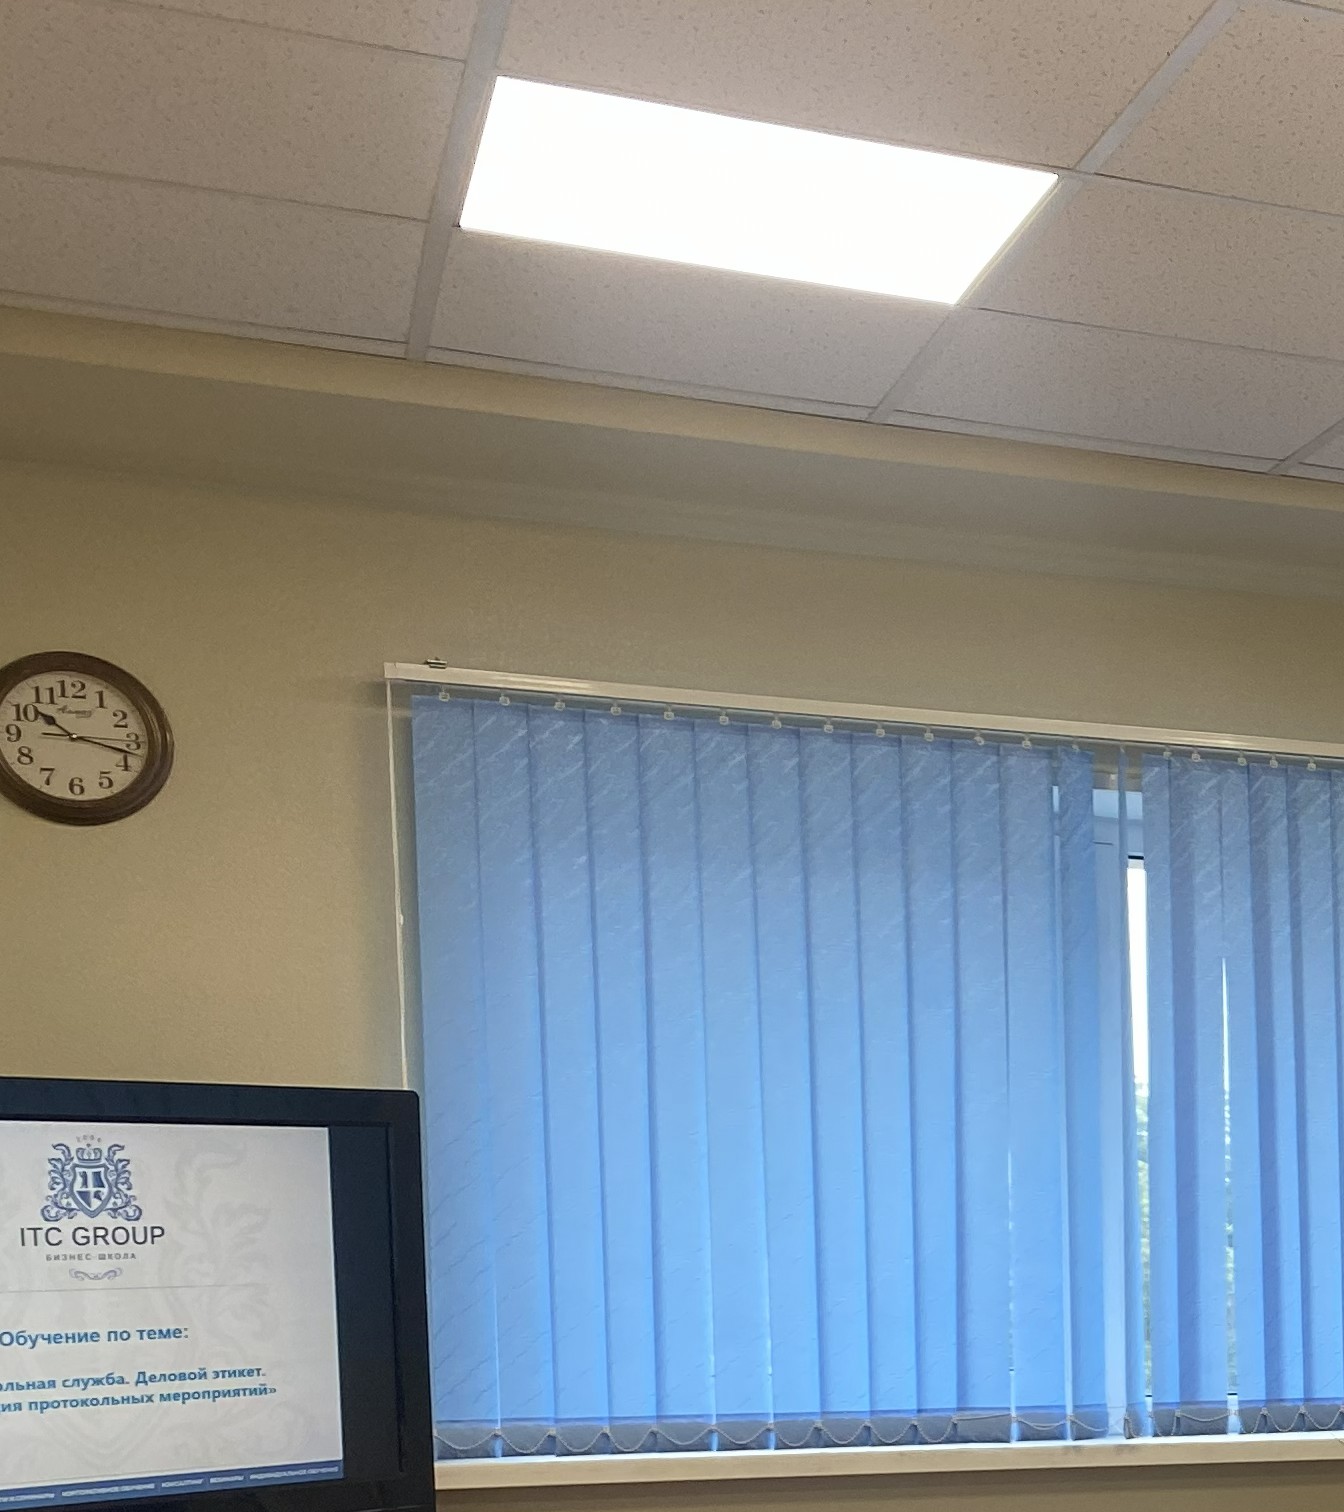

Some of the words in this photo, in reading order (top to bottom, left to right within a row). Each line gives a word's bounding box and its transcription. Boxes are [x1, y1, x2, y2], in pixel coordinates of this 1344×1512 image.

[32, 686, 58, 705] 11
[56, 680, 87, 699] 12
[95, 690, 108, 709] 1
[11, 704, 40, 722] 10
[112, 709, 129, 728] 2
[5, 724, 22, 742] 9
[125, 733, 141, 750] 3
[17, 746, 34, 765] 8
[115, 755, 132, 772] 4
[39, 768, 56, 786] 7
[68, 777, 85, 796] 6
[98, 771, 114, 789] 5
[20, 1227, 63, 1247] ITC
[71, 1226, 165, 1246] GROUP
[0, 1329, 101, 1350] Обучение
[107, 1328, 131, 1342] по
[136, 1327, 189, 1340] теме:
[62, 1372, 130, 1390] служба.
[135, 1368, 208, 1386] Деловой
[212, 1366, 266, 1380] этикет.
[28, 1394, 154, 1414] протокольных
[159, 1384, 277, 1404] мероприятий»
